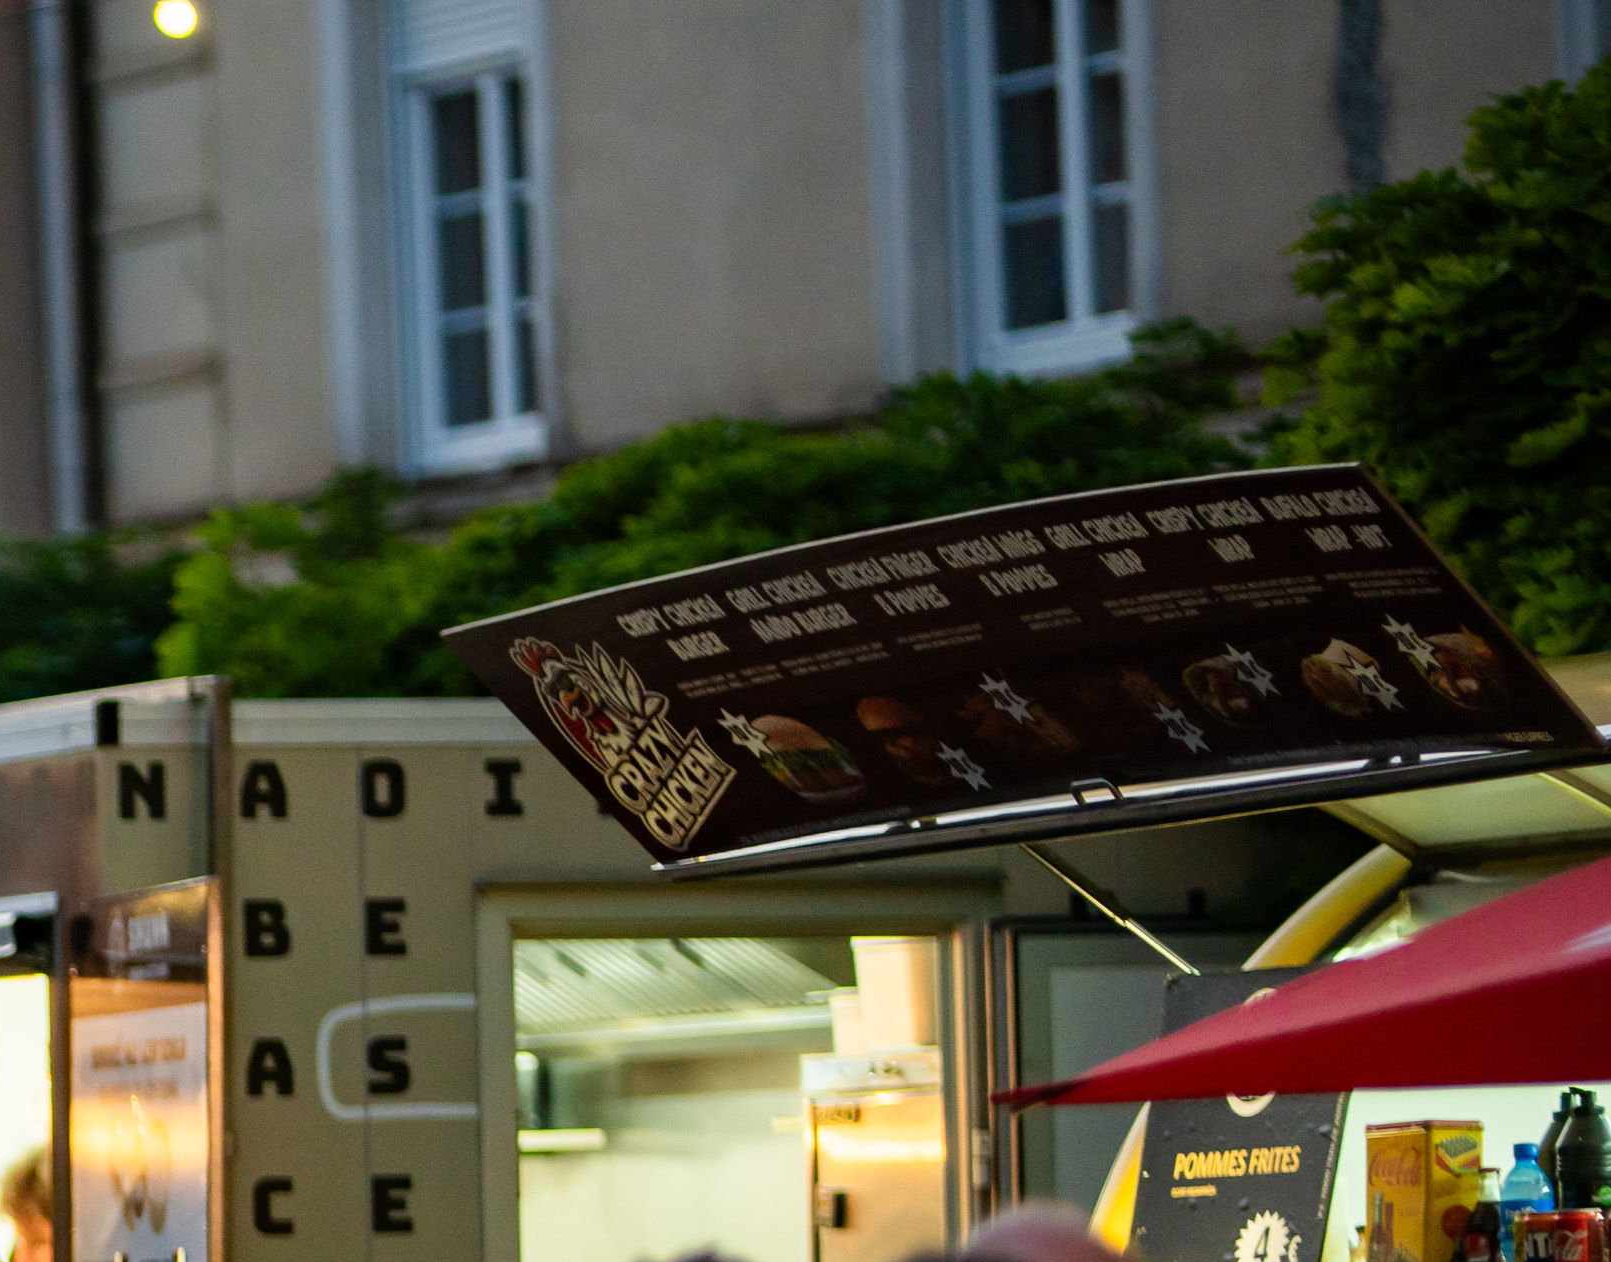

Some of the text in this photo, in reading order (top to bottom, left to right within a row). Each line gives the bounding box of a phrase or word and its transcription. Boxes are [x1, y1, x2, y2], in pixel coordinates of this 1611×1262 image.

[1144, 495, 1266, 535] CRISPY CHICKEN
[1311, 485, 1382, 516] CHICKEN
[935, 528, 1047, 570] CHICKEN WINGS
[1042, 511, 1151, 551] GRILL CHICKEN
[1206, 533, 1257, 564] WRAP
[1304, 523, 1354, 553] WRAP
[825, 549, 942, 592] CHICKEN FINGER
[1097, 547, 1148, 578] WRAP
[725, 569, 828, 615] GRILL CHICKEN
[615, 592, 728, 639] CRISPY CHICKEN
[791, 602, 859, 634] BURGER
[665, 629, 731, 662] BURGER
[609, 715, 682, 812] CRAZY
[644, 736, 729, 848] CHICKEN
[1173, 1144, 1302, 1181] POMMES FRITES
